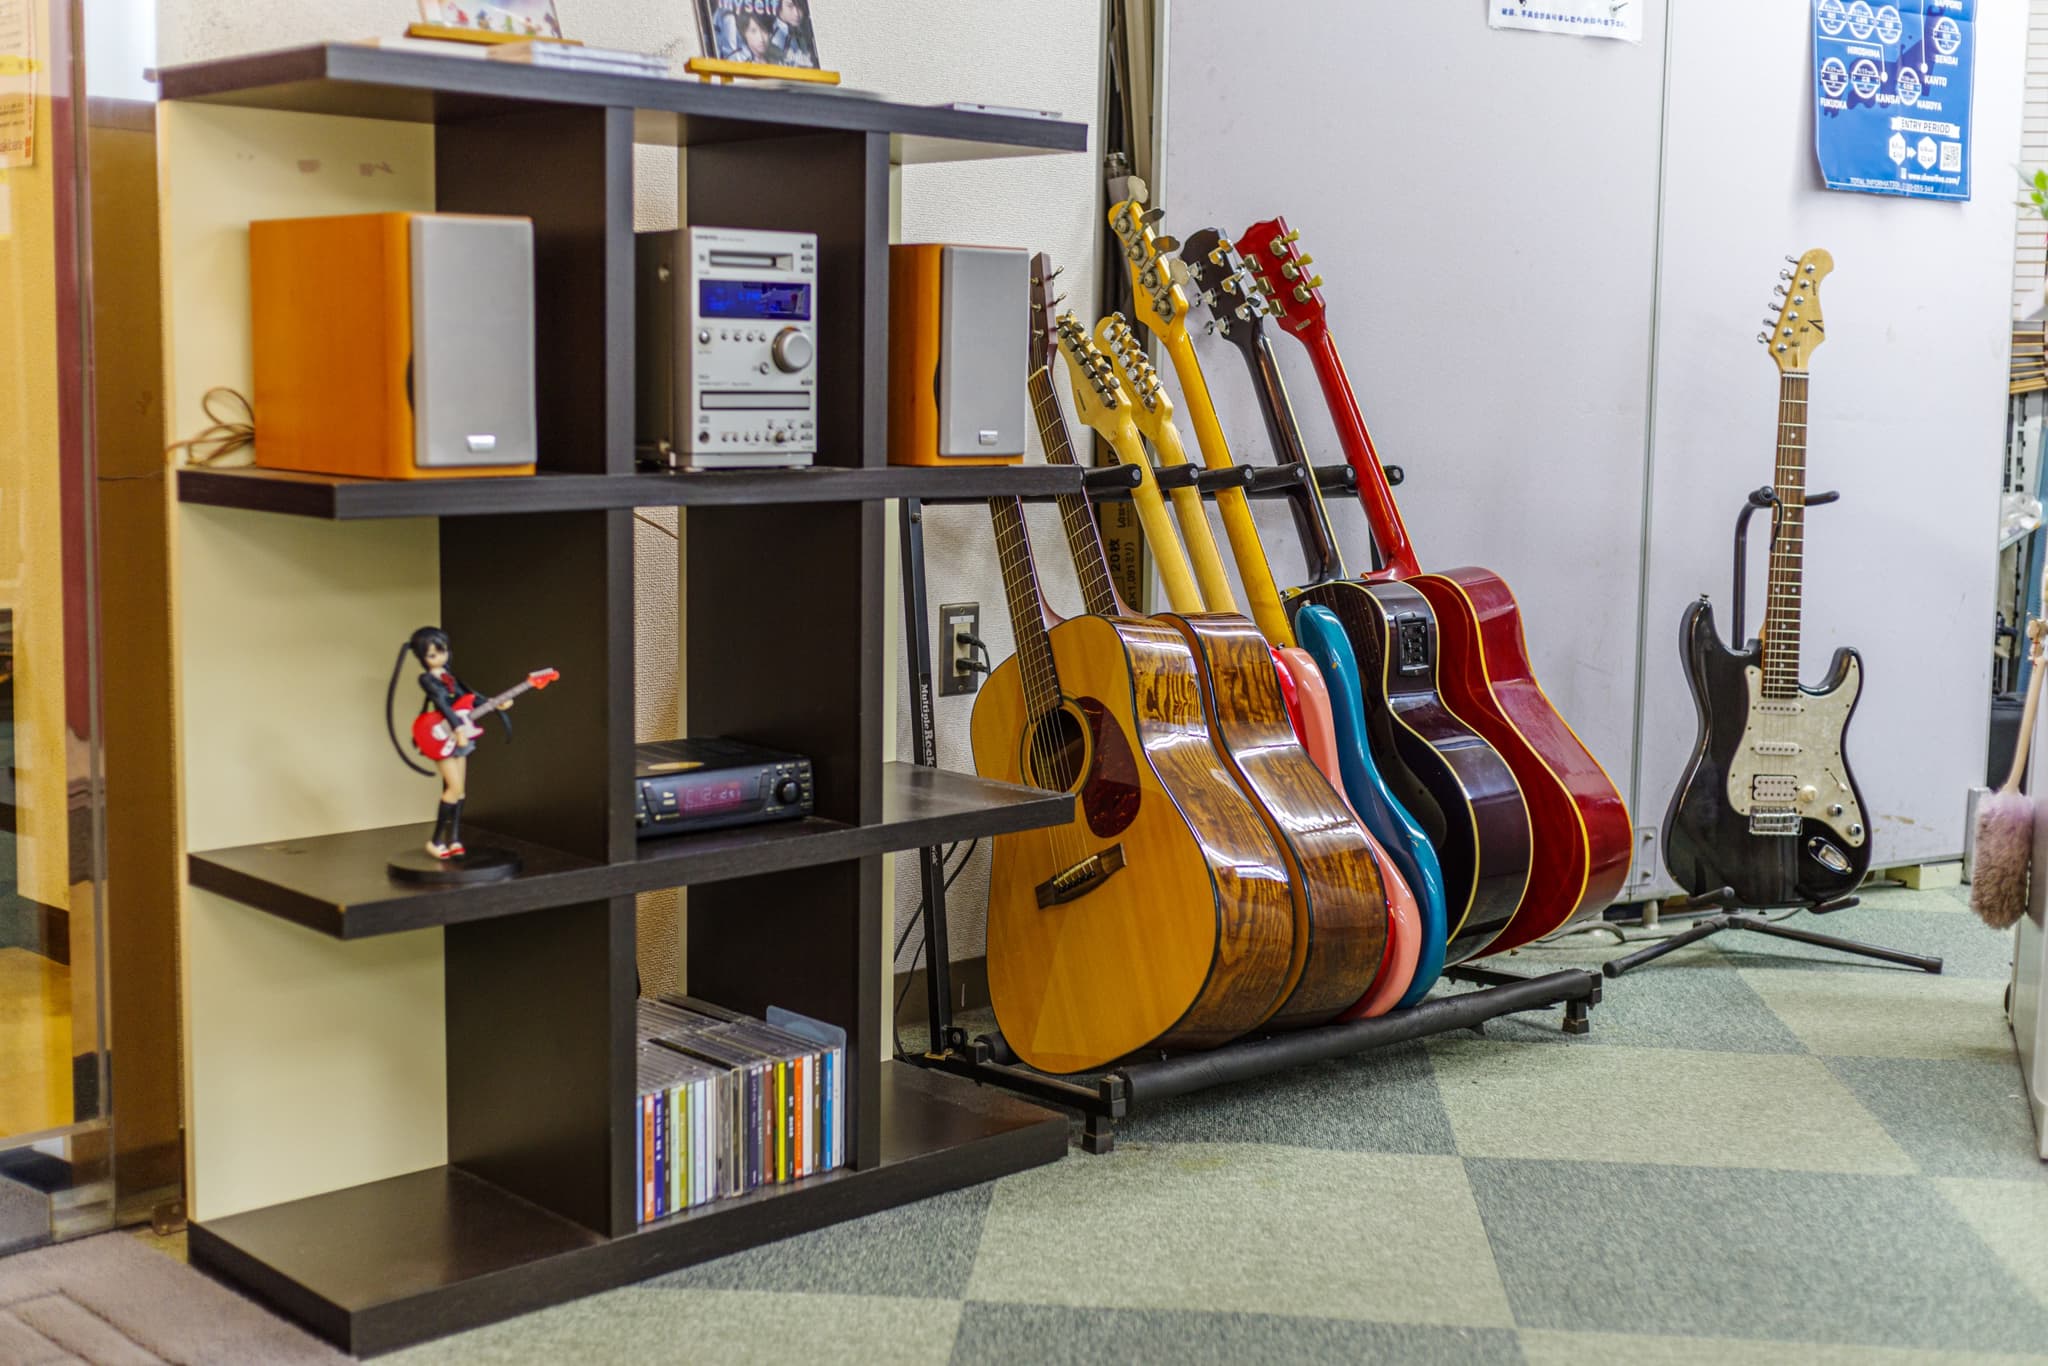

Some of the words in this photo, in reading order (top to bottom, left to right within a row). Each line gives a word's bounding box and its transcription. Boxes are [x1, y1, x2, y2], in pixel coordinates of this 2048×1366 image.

[1935, 54, 1958, 66] SENDAI
[1924, 75, 1947, 87] KANTO
[1820, 97, 1847, 110] FUKUOKA
[1876, 94, 1900, 105] KANSA
[1917, 100, 1942, 111] NAGOYA
[1901, 118, 1922, 129] ENTRY
[1923, 121, 1950, 134] PERIOD
[1110, 538, 1121, 572] 20枚
